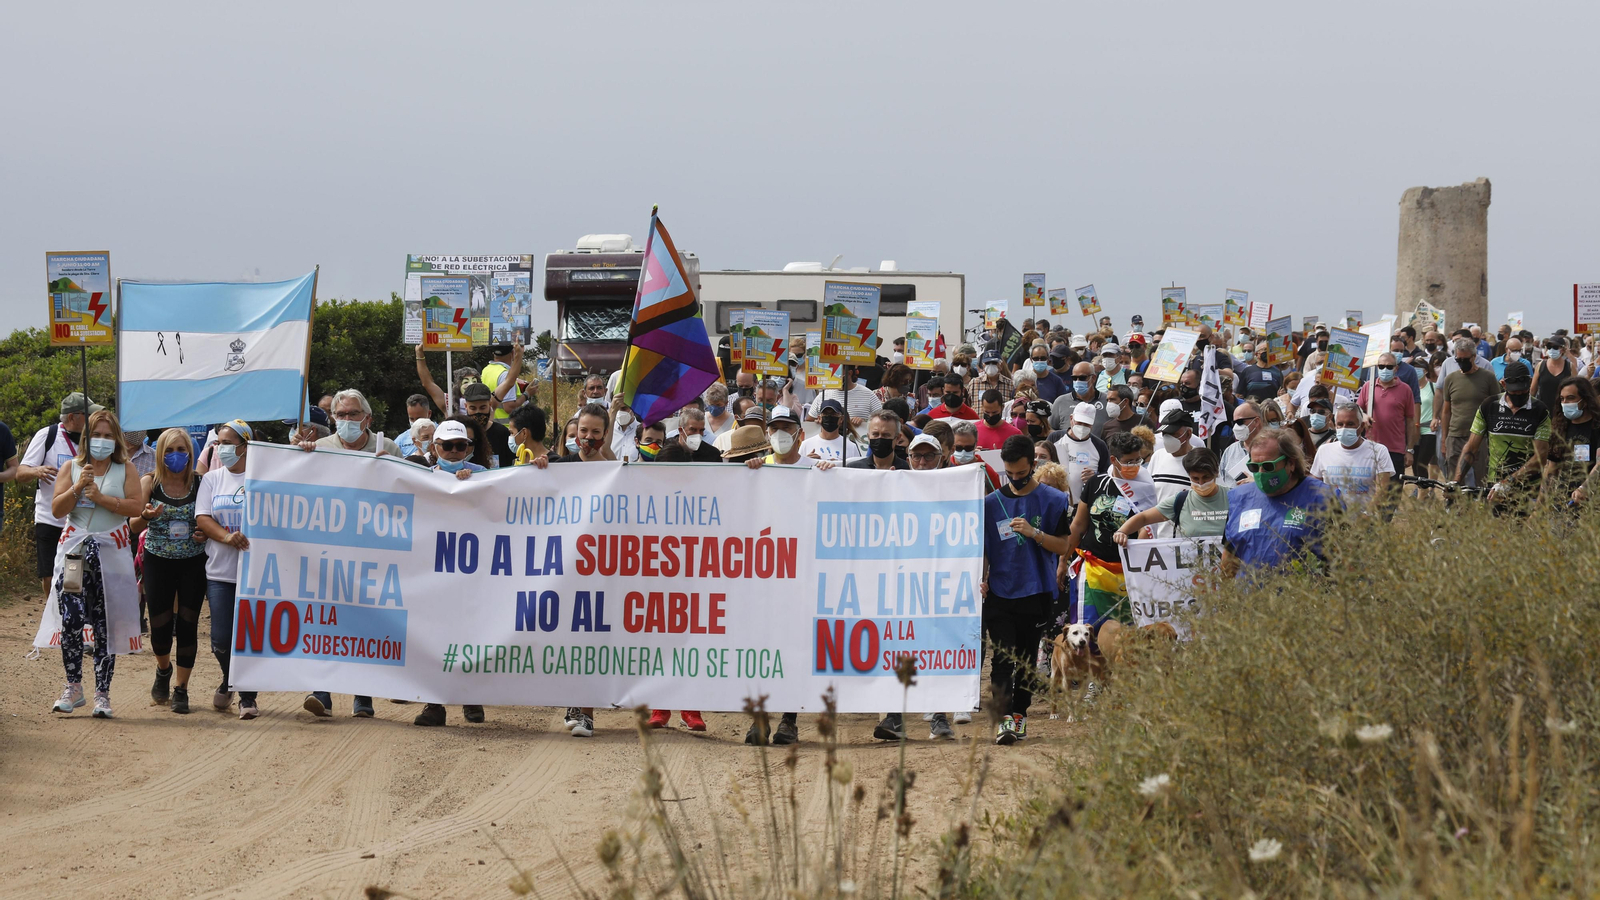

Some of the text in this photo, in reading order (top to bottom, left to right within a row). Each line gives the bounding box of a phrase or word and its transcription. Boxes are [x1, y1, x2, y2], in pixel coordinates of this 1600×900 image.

[55, 324, 70, 338] NO
[426, 333, 438, 344] NO
[824, 343, 838, 356] NO
[1002, 331, 1020, 358] VERDE
[745, 360, 756, 370] NO
[906, 356, 914, 364] NO
[1149, 366, 1159, 374] NO
[808, 376, 817, 385] NO
[1324, 370, 1334, 380] NO
[1493, 420, 1532, 432] Genal
[1121, 482, 1134, 498] NO
[246, 491, 408, 538] UNIDAD POR
[506, 490, 721, 525] UNIDAD POR LA LÍNEA
[821, 513, 919, 548] UNIDAD
[929, 512, 979, 546] POR
[435, 527, 797, 579] NO A LA SUBESTACIÓN
[1123, 547, 1168, 572] LA
[240, 551, 403, 607] LA LÍNEA
[816, 565, 976, 616] LA LÍNEA
[304, 604, 337, 625] A LA
[515, 590, 726, 634] NO AL CABLE
[235, 599, 300, 653] NO
[883, 620, 915, 640] A LA
[302, 634, 401, 660] SUBESTACIÓN
[816, 619, 880, 672] NO
[442, 644, 784, 679] #SIERRA CARBONERA NO SE TOCA
